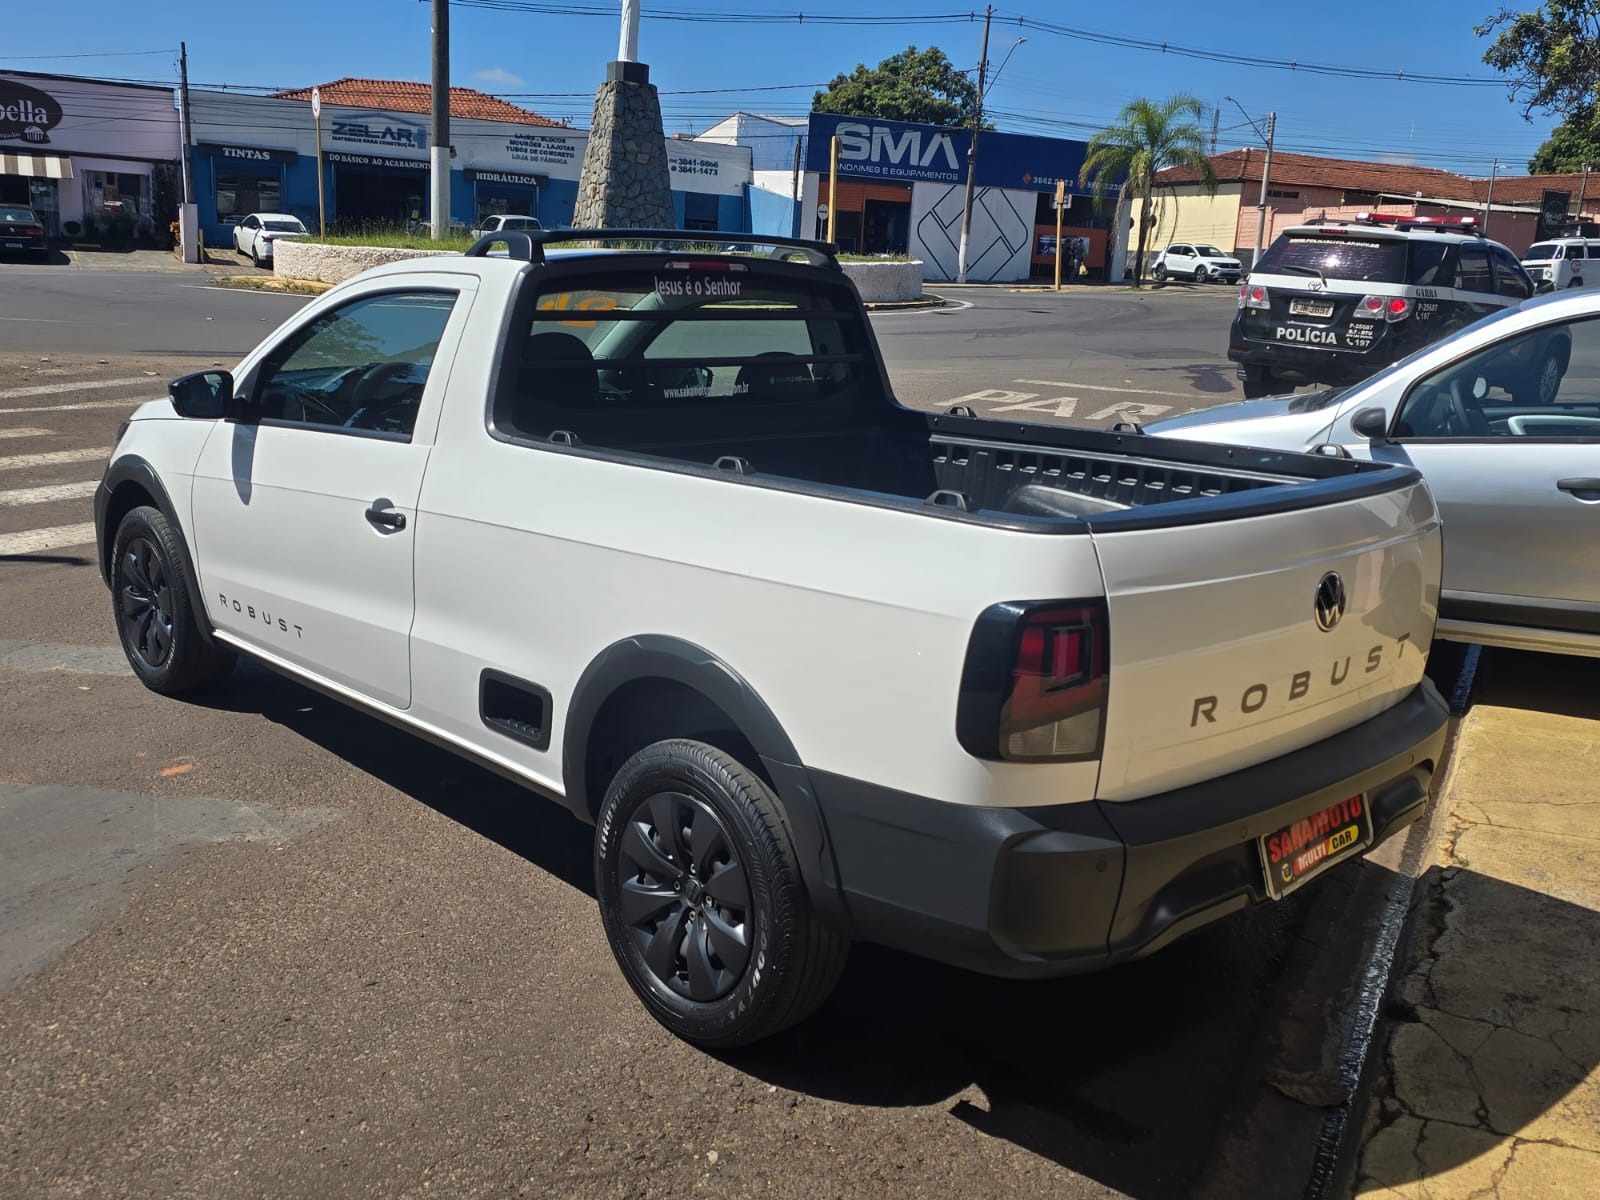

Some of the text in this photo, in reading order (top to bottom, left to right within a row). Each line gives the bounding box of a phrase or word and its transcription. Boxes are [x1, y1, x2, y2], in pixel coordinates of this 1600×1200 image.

[332, 121, 413, 142] ZELAR
[222, 147, 271, 161] TINTAS
[540, 150, 575, 159] CONCRETO
[546, 143, 575, 152] LAJOTAS
[835, 122, 960, 170] SMA
[329, 153, 431, 170] DO BÁSICO AO ACABAMENT
[475, 171, 537, 186] HIDRÁULICA
[882, 167, 889, 175] E
[890, 168, 959, 180] EQUIPAMENTOS
[654, 275, 742, 296] Jesus é o Senhor
[1421, 312, 1430, 320] 197
[1276, 327, 1338, 345] POLÍCIA
[1355, 339, 1371, 347] 197
[219, 593, 303, 638] ROBUST
[1190, 632, 1411, 728] ROBUST
[1269, 795, 1362, 864] SAKAMOTO
[1298, 830, 1353, 871] MULTI CAR
